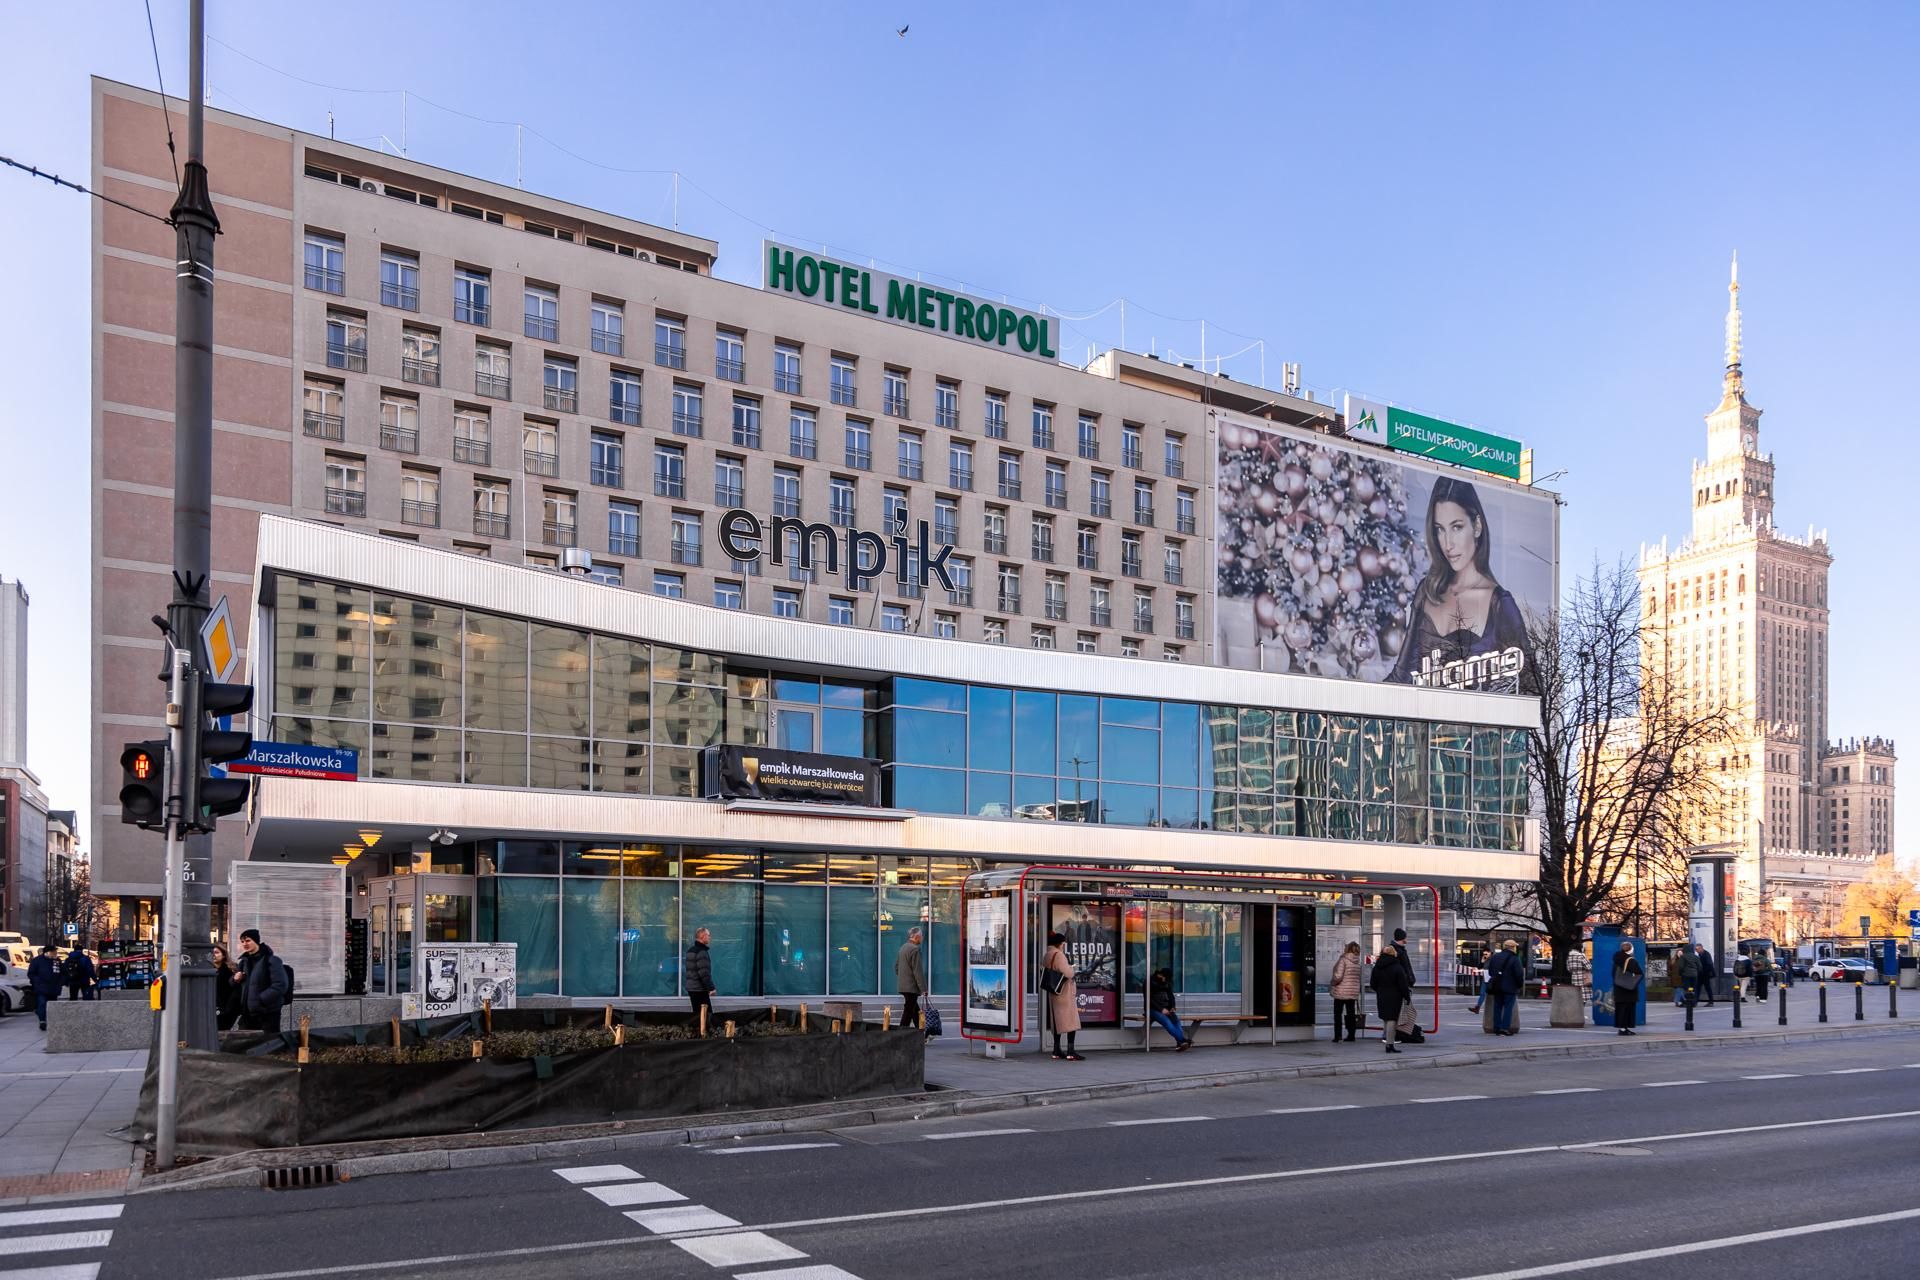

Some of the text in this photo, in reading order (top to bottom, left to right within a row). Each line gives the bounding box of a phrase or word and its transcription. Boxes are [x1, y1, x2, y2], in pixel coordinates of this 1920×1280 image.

[769, 247, 1055, 358] HOTEL METROPOL
[1395, 422, 1518, 465] HOTELMETROPOL.COM.PL
[718, 507, 957, 592] empik
[245, 749, 342, 769] Marszałkowska
[295, 768, 326, 777] Południowe
[760, 762, 864, 781] empik Marszałkowska
[760, 776, 864, 793] wielkie otwarcie już wkrótce!
[67, 925, 75, 934] P
[426, 950, 446, 958] SUP
[1065, 943, 1112, 955] LEBODA
